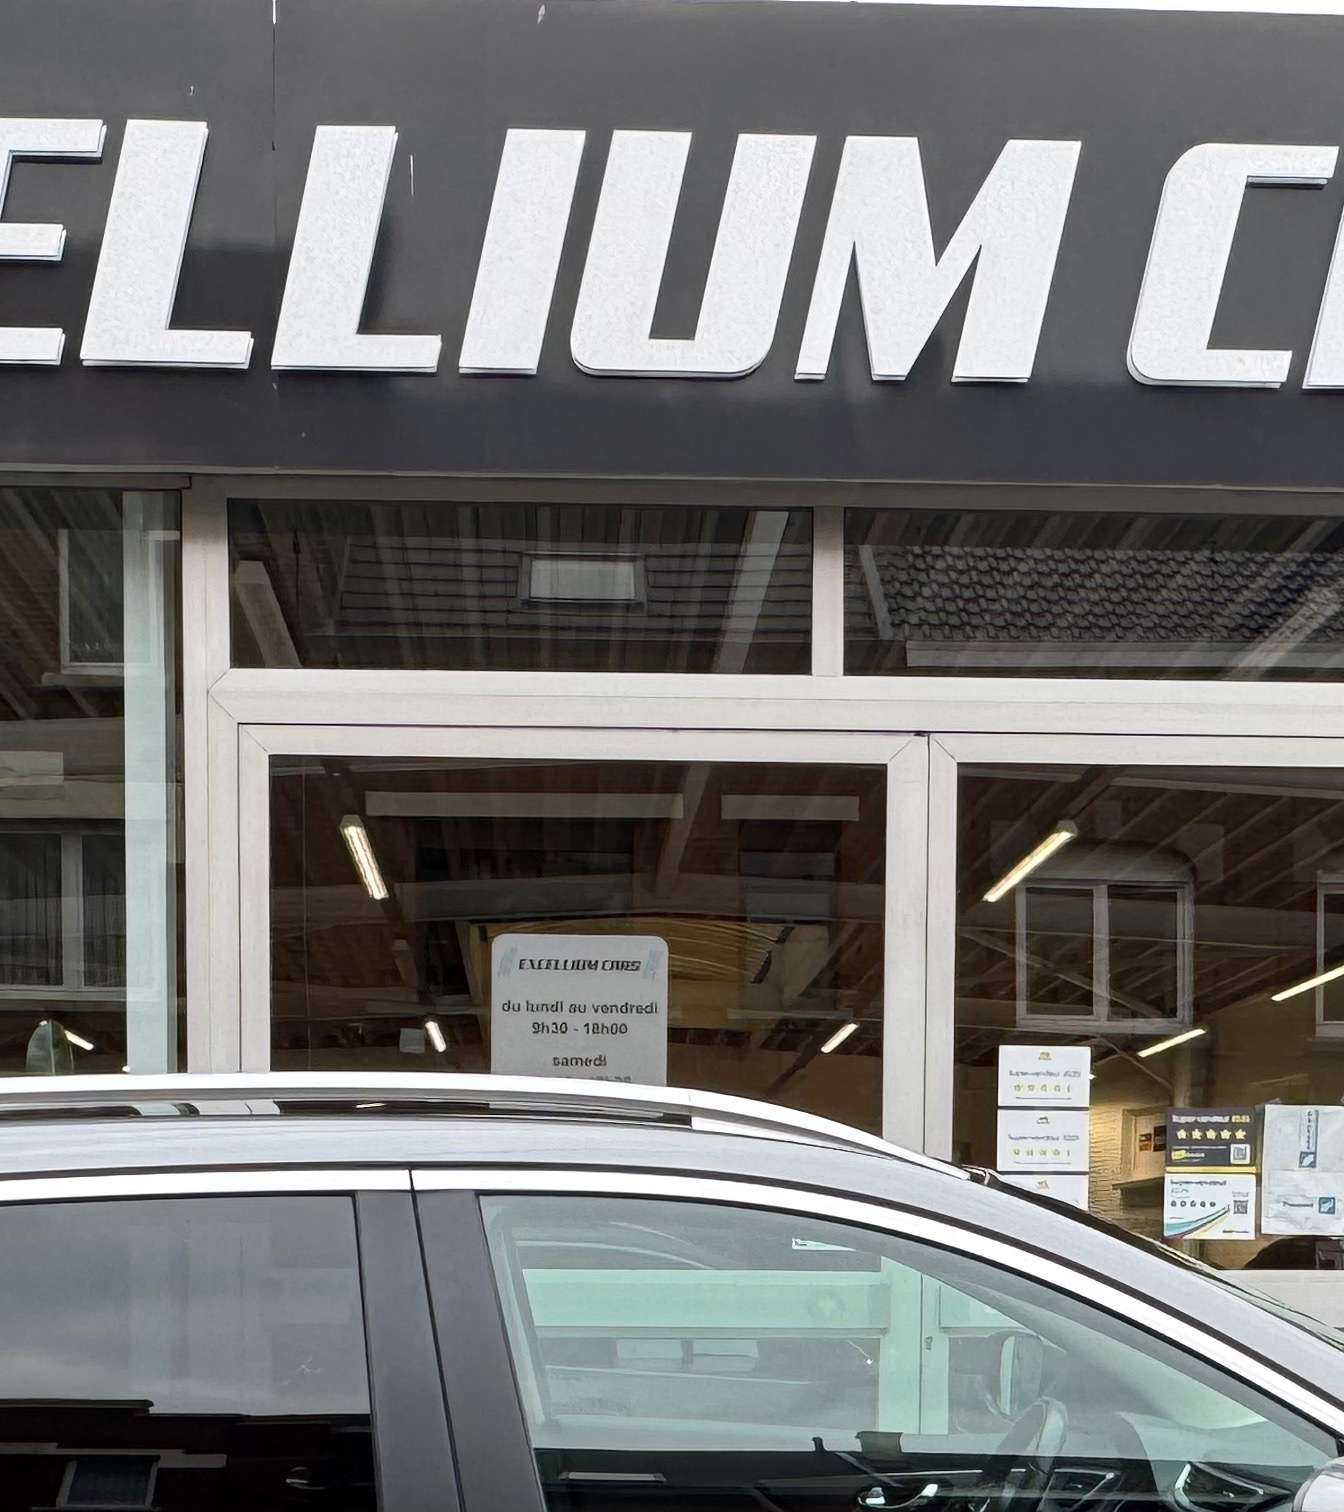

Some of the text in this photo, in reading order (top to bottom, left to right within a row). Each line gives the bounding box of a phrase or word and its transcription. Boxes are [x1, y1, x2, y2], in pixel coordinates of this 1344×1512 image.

[518, 958, 599, 971] EXCELLIUM
[502, 1000, 658, 1014] du lundi au vendredi
[531, 1022, 568, 1035] 9h30
[583, 1022, 628, 1035] 18h00
[552, 1054, 608, 1068] samedi
